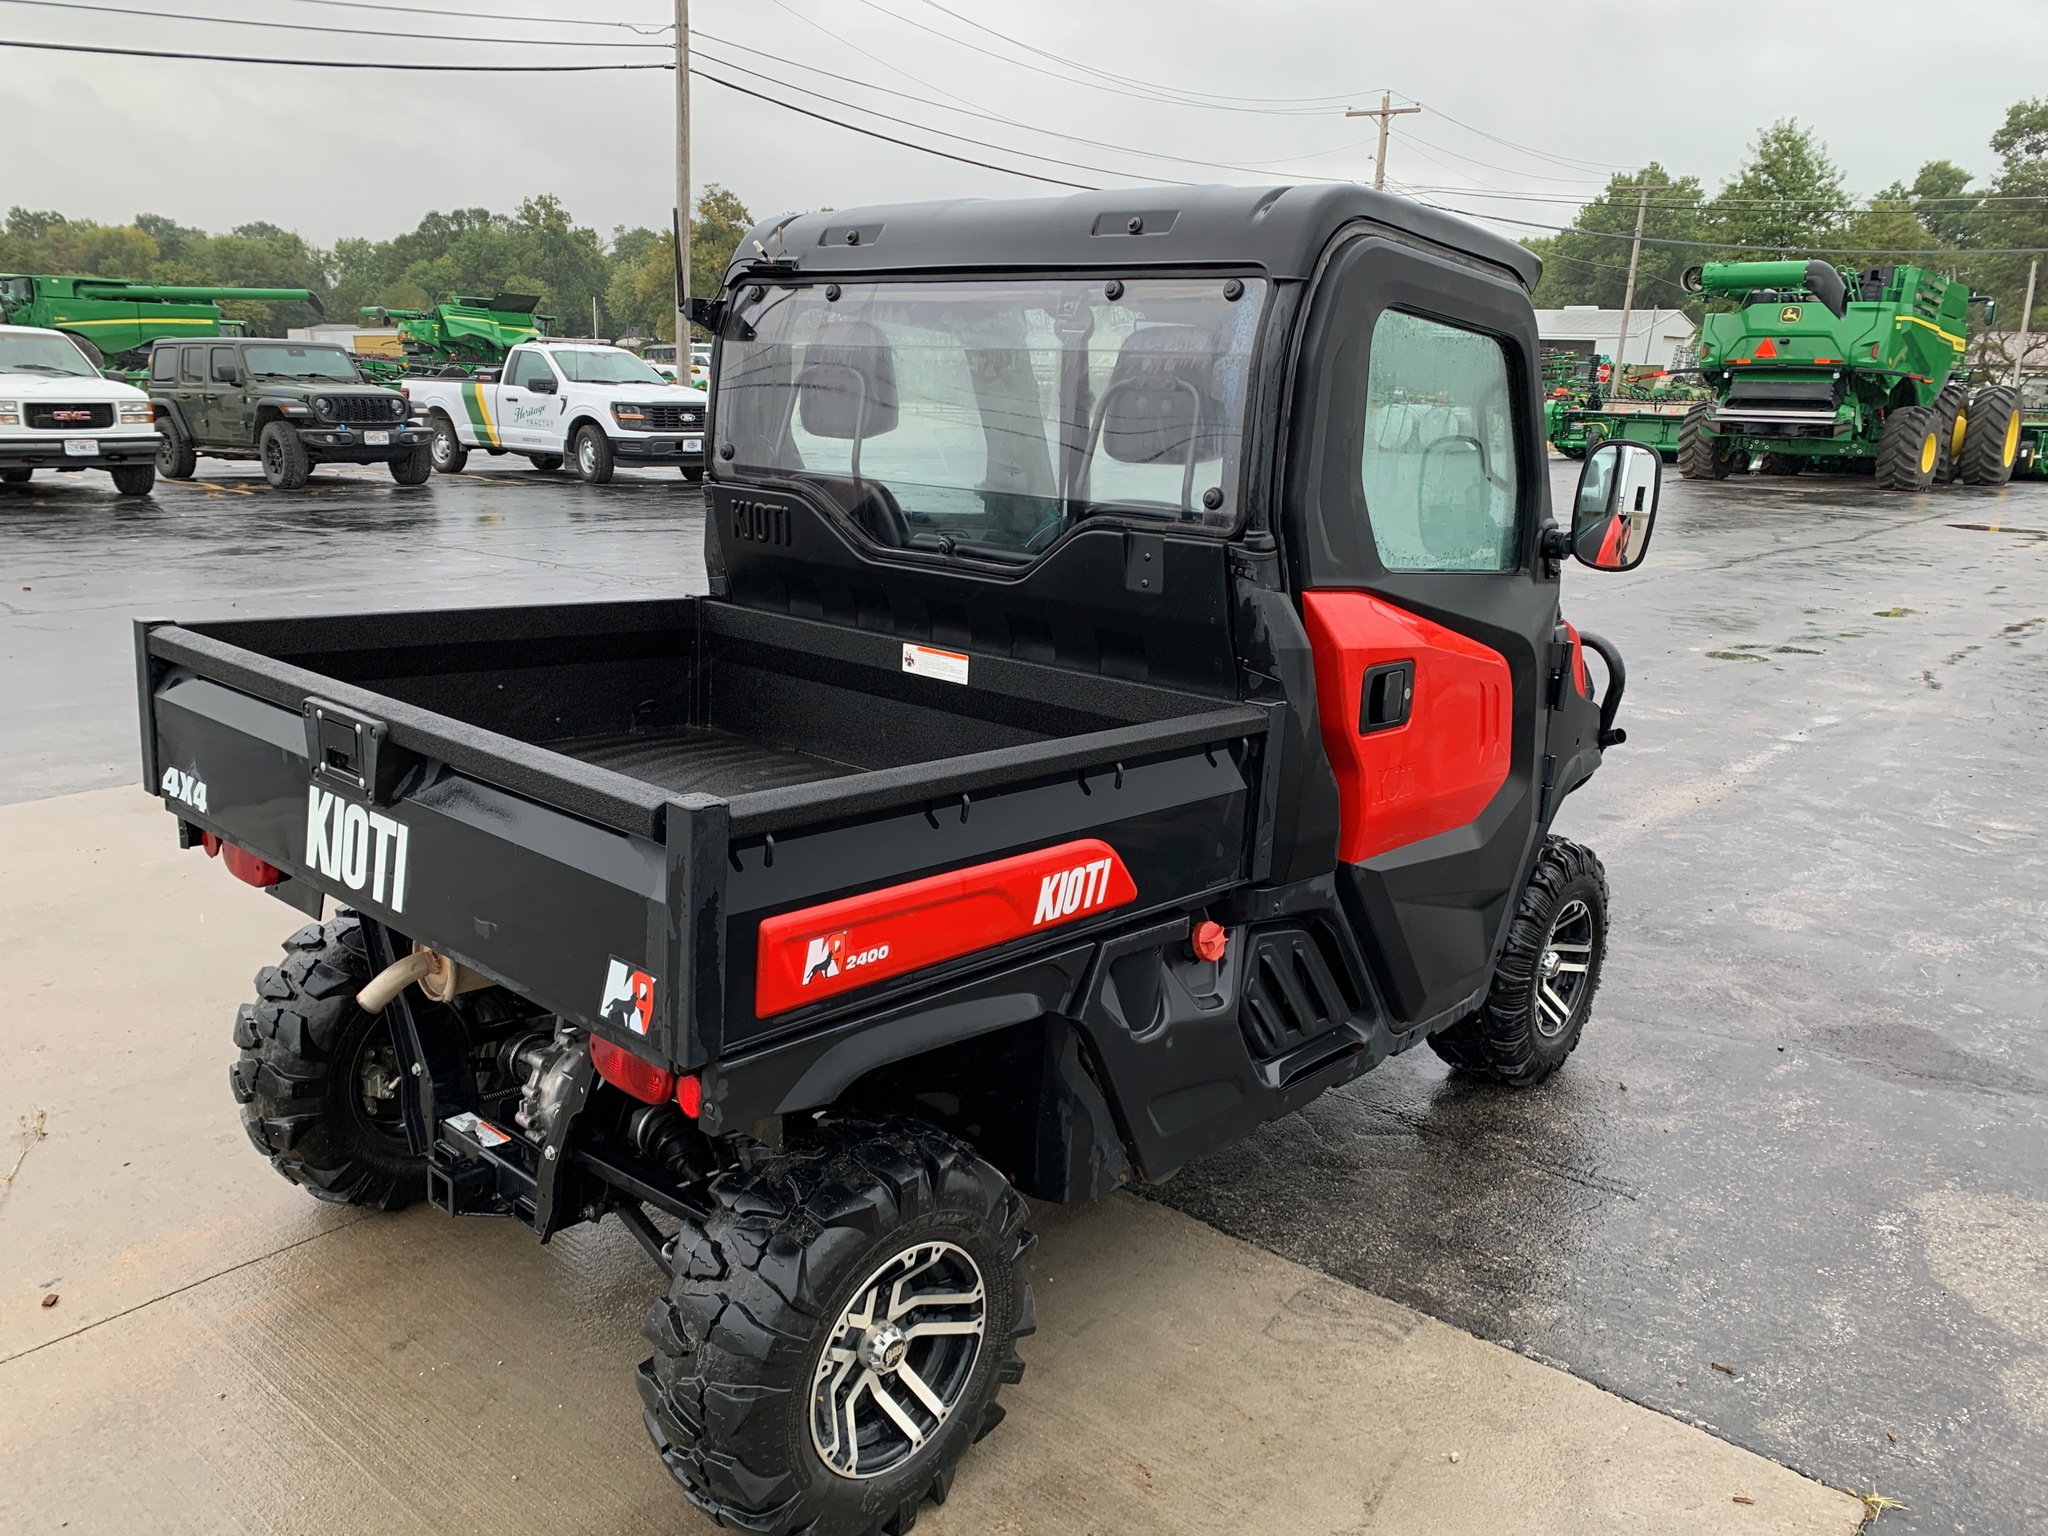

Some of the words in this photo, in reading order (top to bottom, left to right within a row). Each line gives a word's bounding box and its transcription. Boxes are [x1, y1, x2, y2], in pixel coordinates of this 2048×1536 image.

[53, 411, 91, 420] GMC
[514, 404, 547, 422] Heritage
[731, 499, 791, 546] KIOTI
[305, 785, 409, 913] KIOTI
[1033, 858, 1112, 925] KIOTI
[846, 945, 890, 970] 2400
